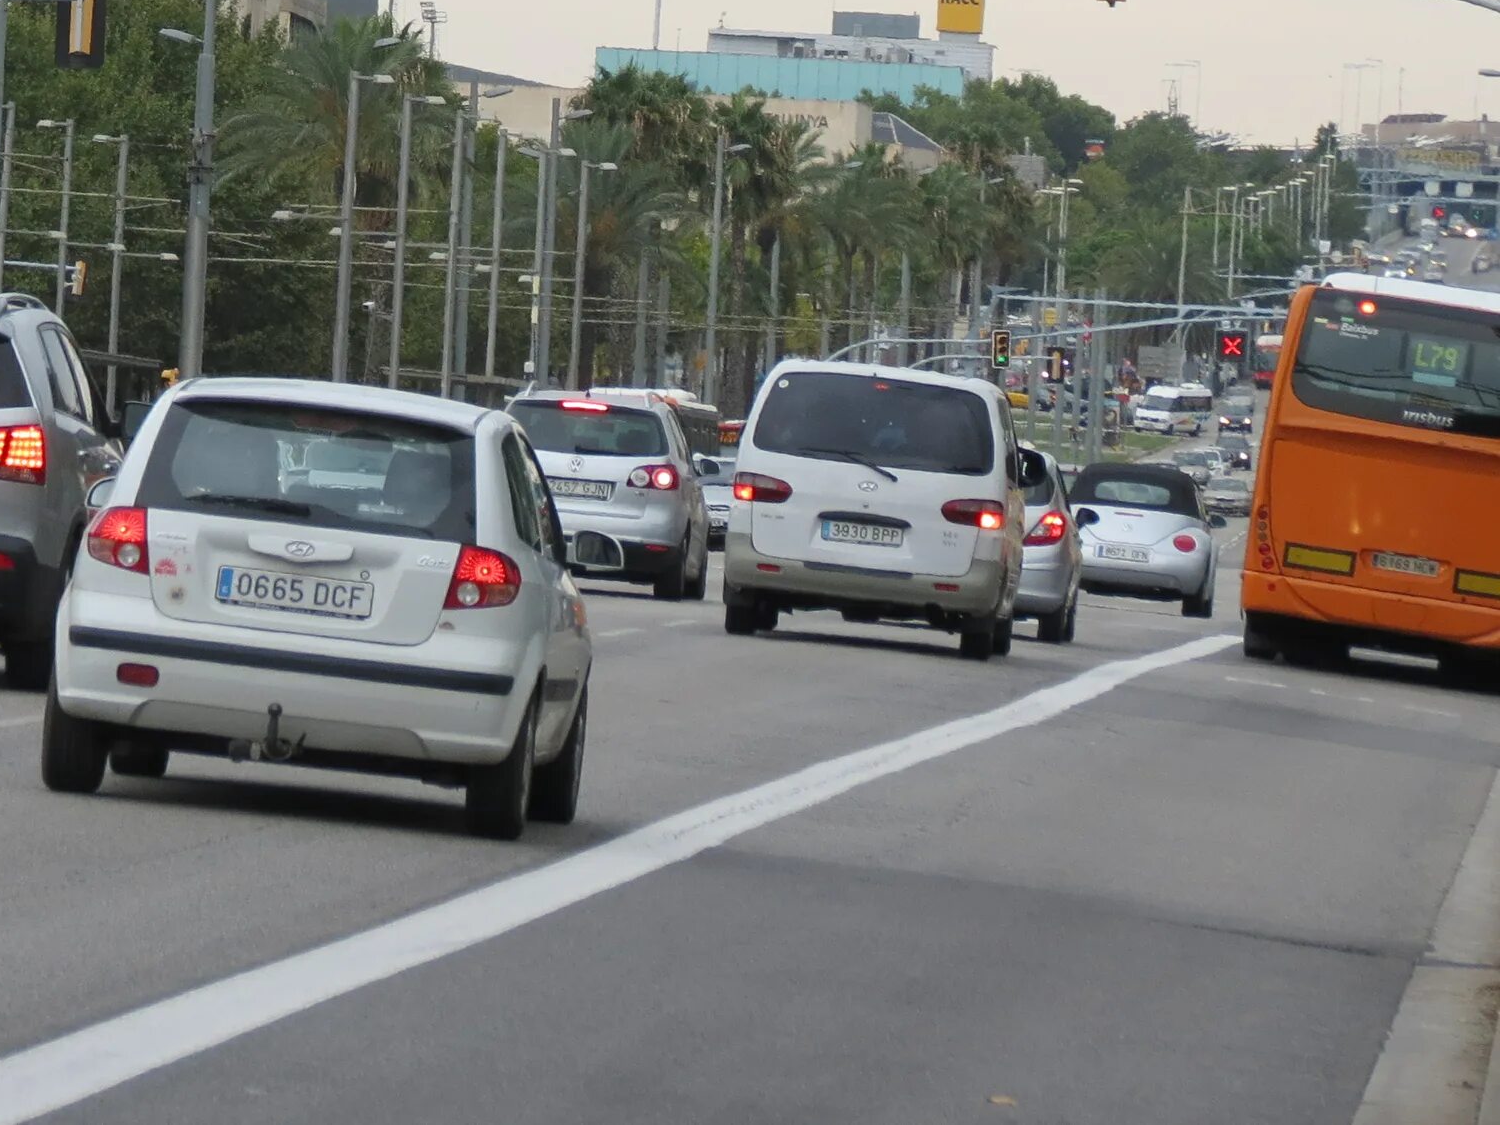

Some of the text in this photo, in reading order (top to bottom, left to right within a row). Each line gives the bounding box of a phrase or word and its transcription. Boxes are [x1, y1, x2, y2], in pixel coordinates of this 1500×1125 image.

[1415, 343, 1458, 371] L79
[1403, 411, 1454, 427] irisbus
[831, 523, 899, 541] 3930 BPP
[237, 572, 304, 603] 0665
[313, 582, 365, 609] DCF
